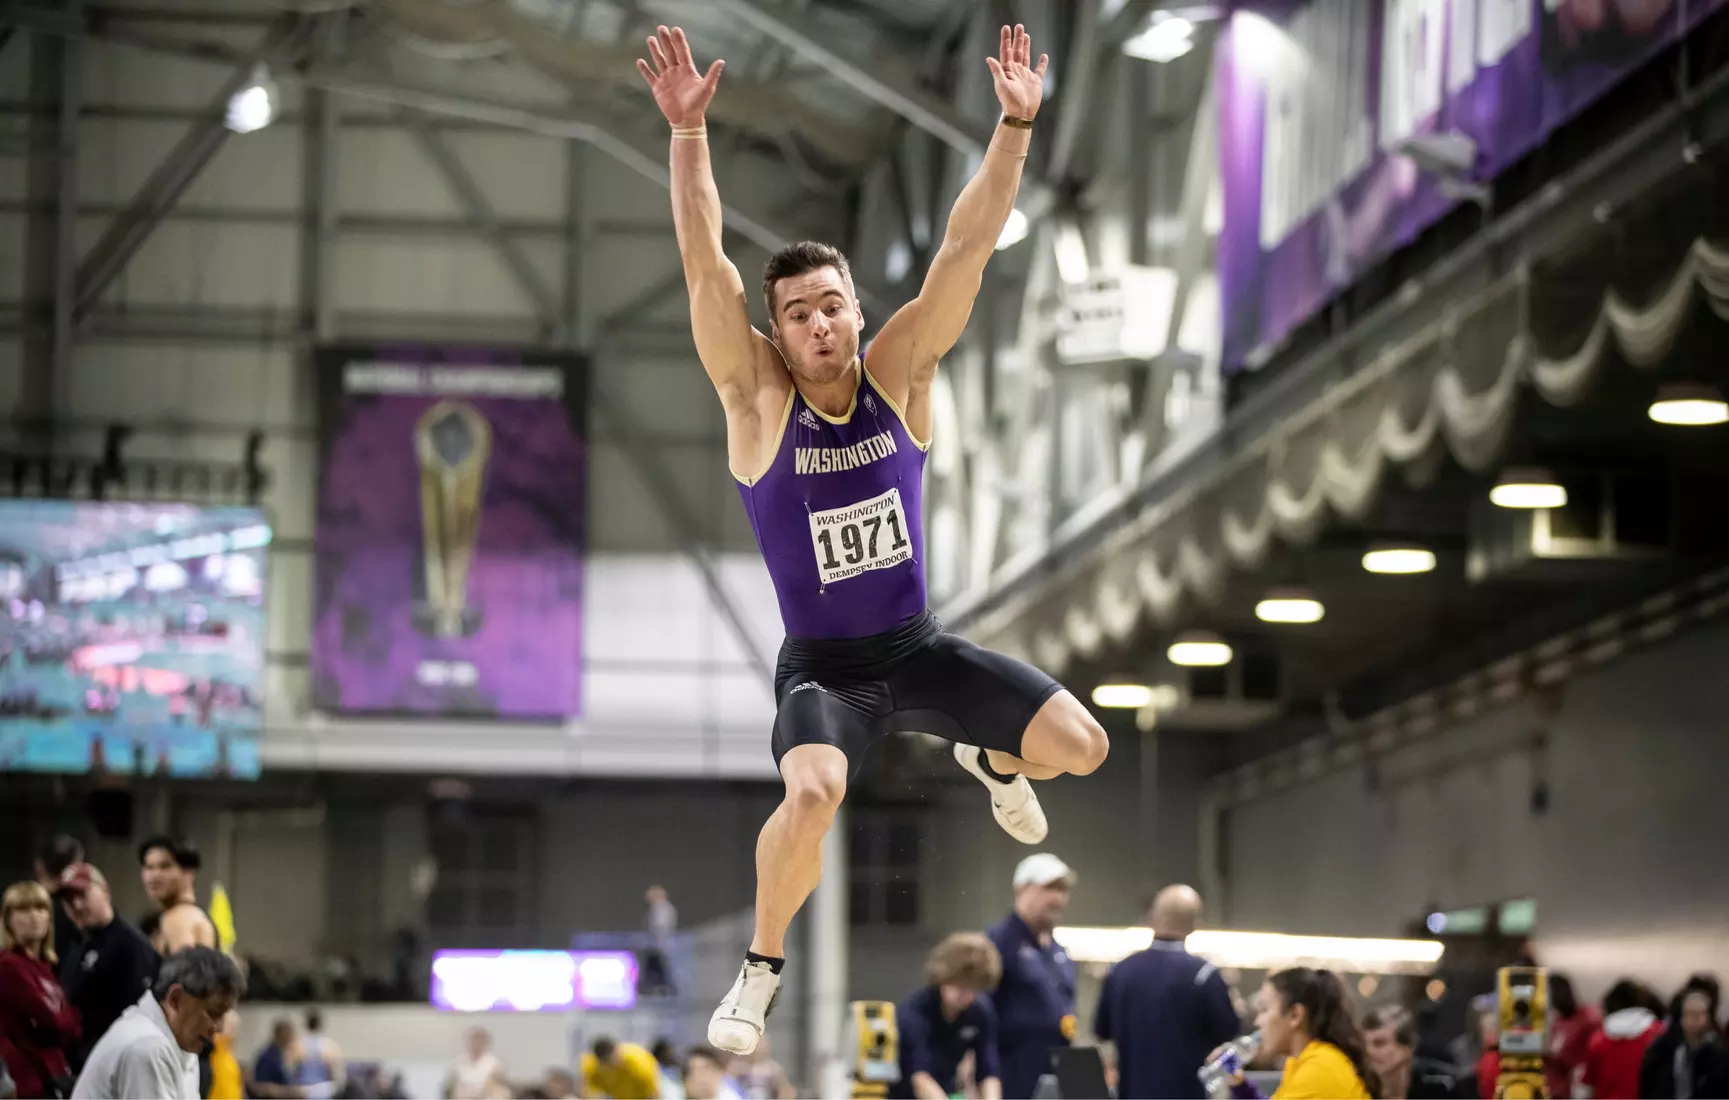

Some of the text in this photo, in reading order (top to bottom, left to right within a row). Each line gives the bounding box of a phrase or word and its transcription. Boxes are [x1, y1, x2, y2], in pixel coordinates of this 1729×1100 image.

[795, 430, 898, 474] WASHINGTON
[816, 495, 895, 526] WASHINGTON
[818, 509, 908, 570] 1971
[829, 551, 908, 580] DEMPSEY INDOOR
